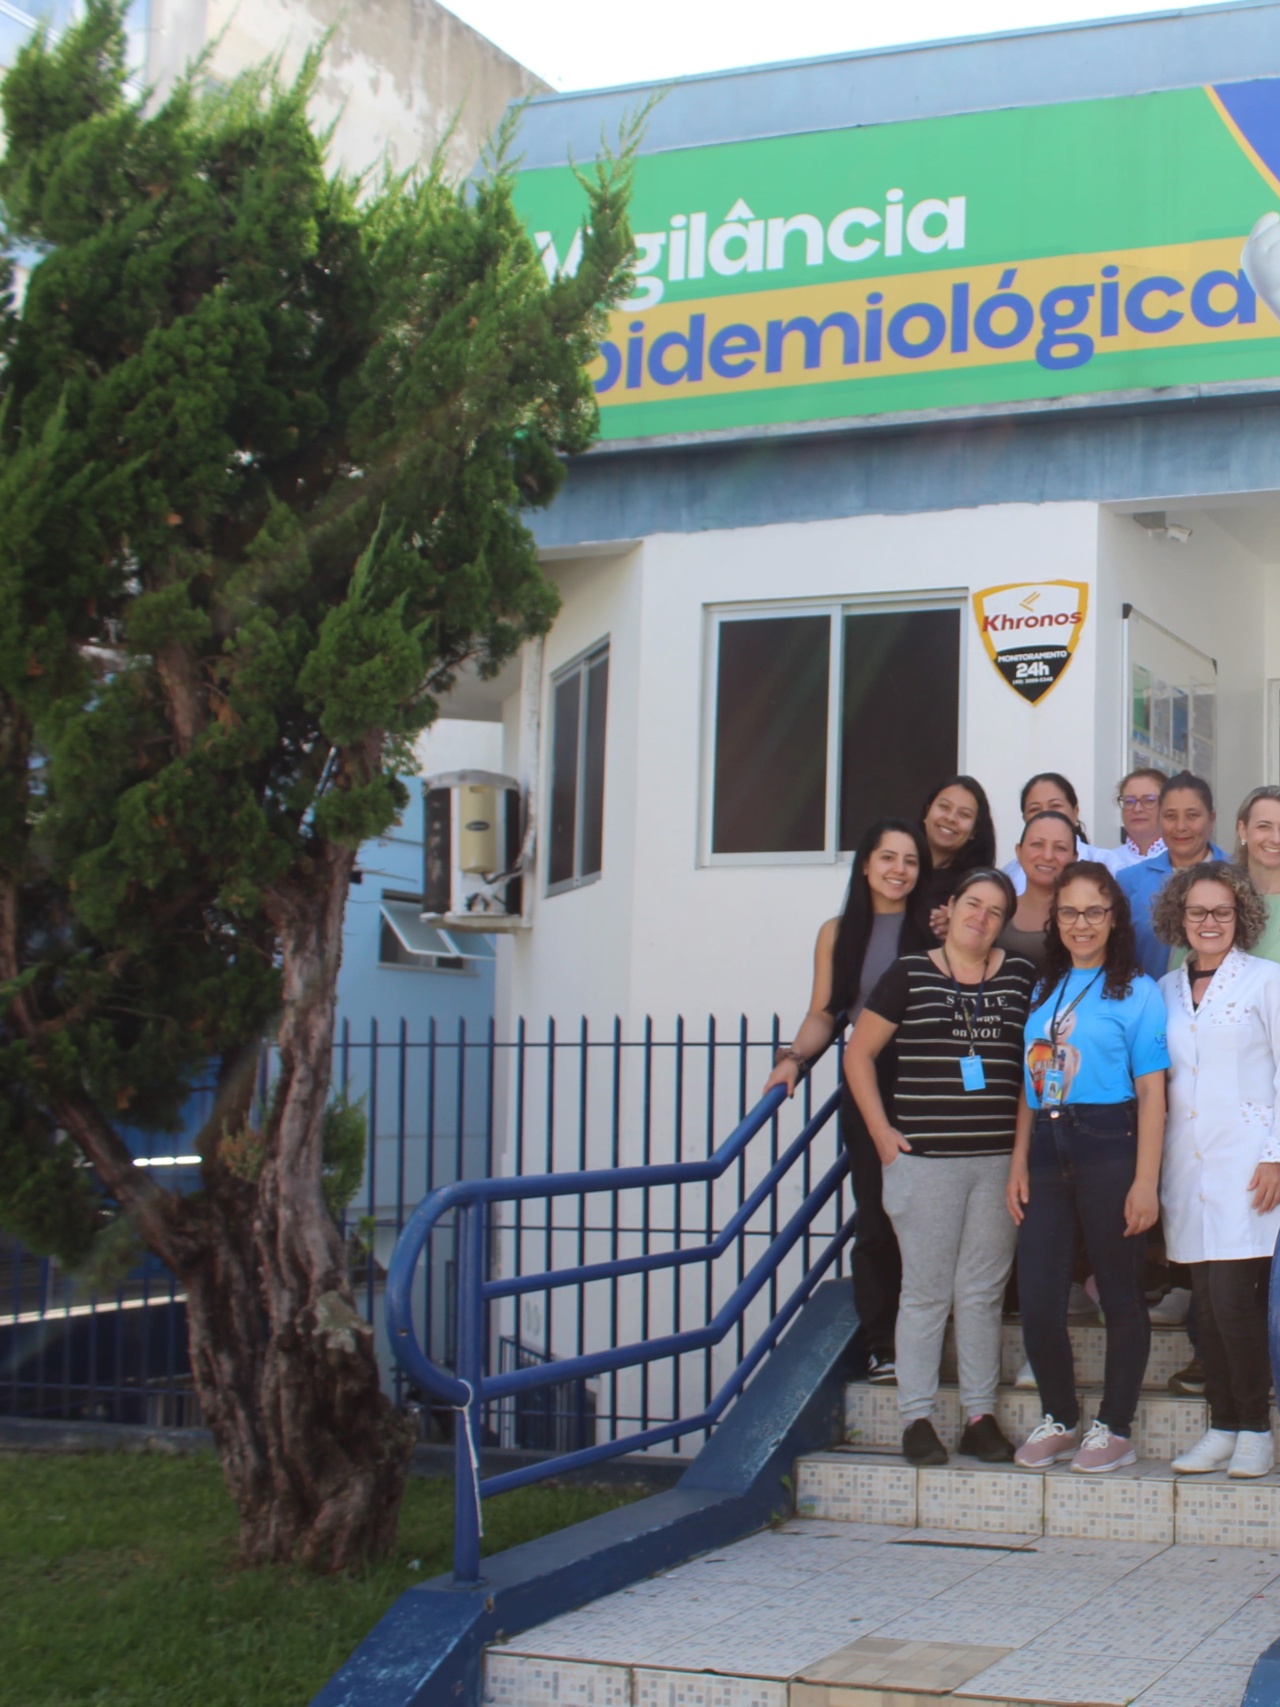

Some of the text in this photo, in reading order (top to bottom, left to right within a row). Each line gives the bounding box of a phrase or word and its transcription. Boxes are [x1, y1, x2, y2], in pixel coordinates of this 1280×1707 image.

[533, 187, 966, 312] Vgilância
[592, 264, 1257, 371] idemiológica
[982, 611, 1083, 633] Khronos
[997, 650, 1068, 663] MONITORAMENTO
[1015, 661, 1050, 678] 24h
[954, 1011, 963, 1020] is
[952, 1028, 1001, 1038] on YOU
